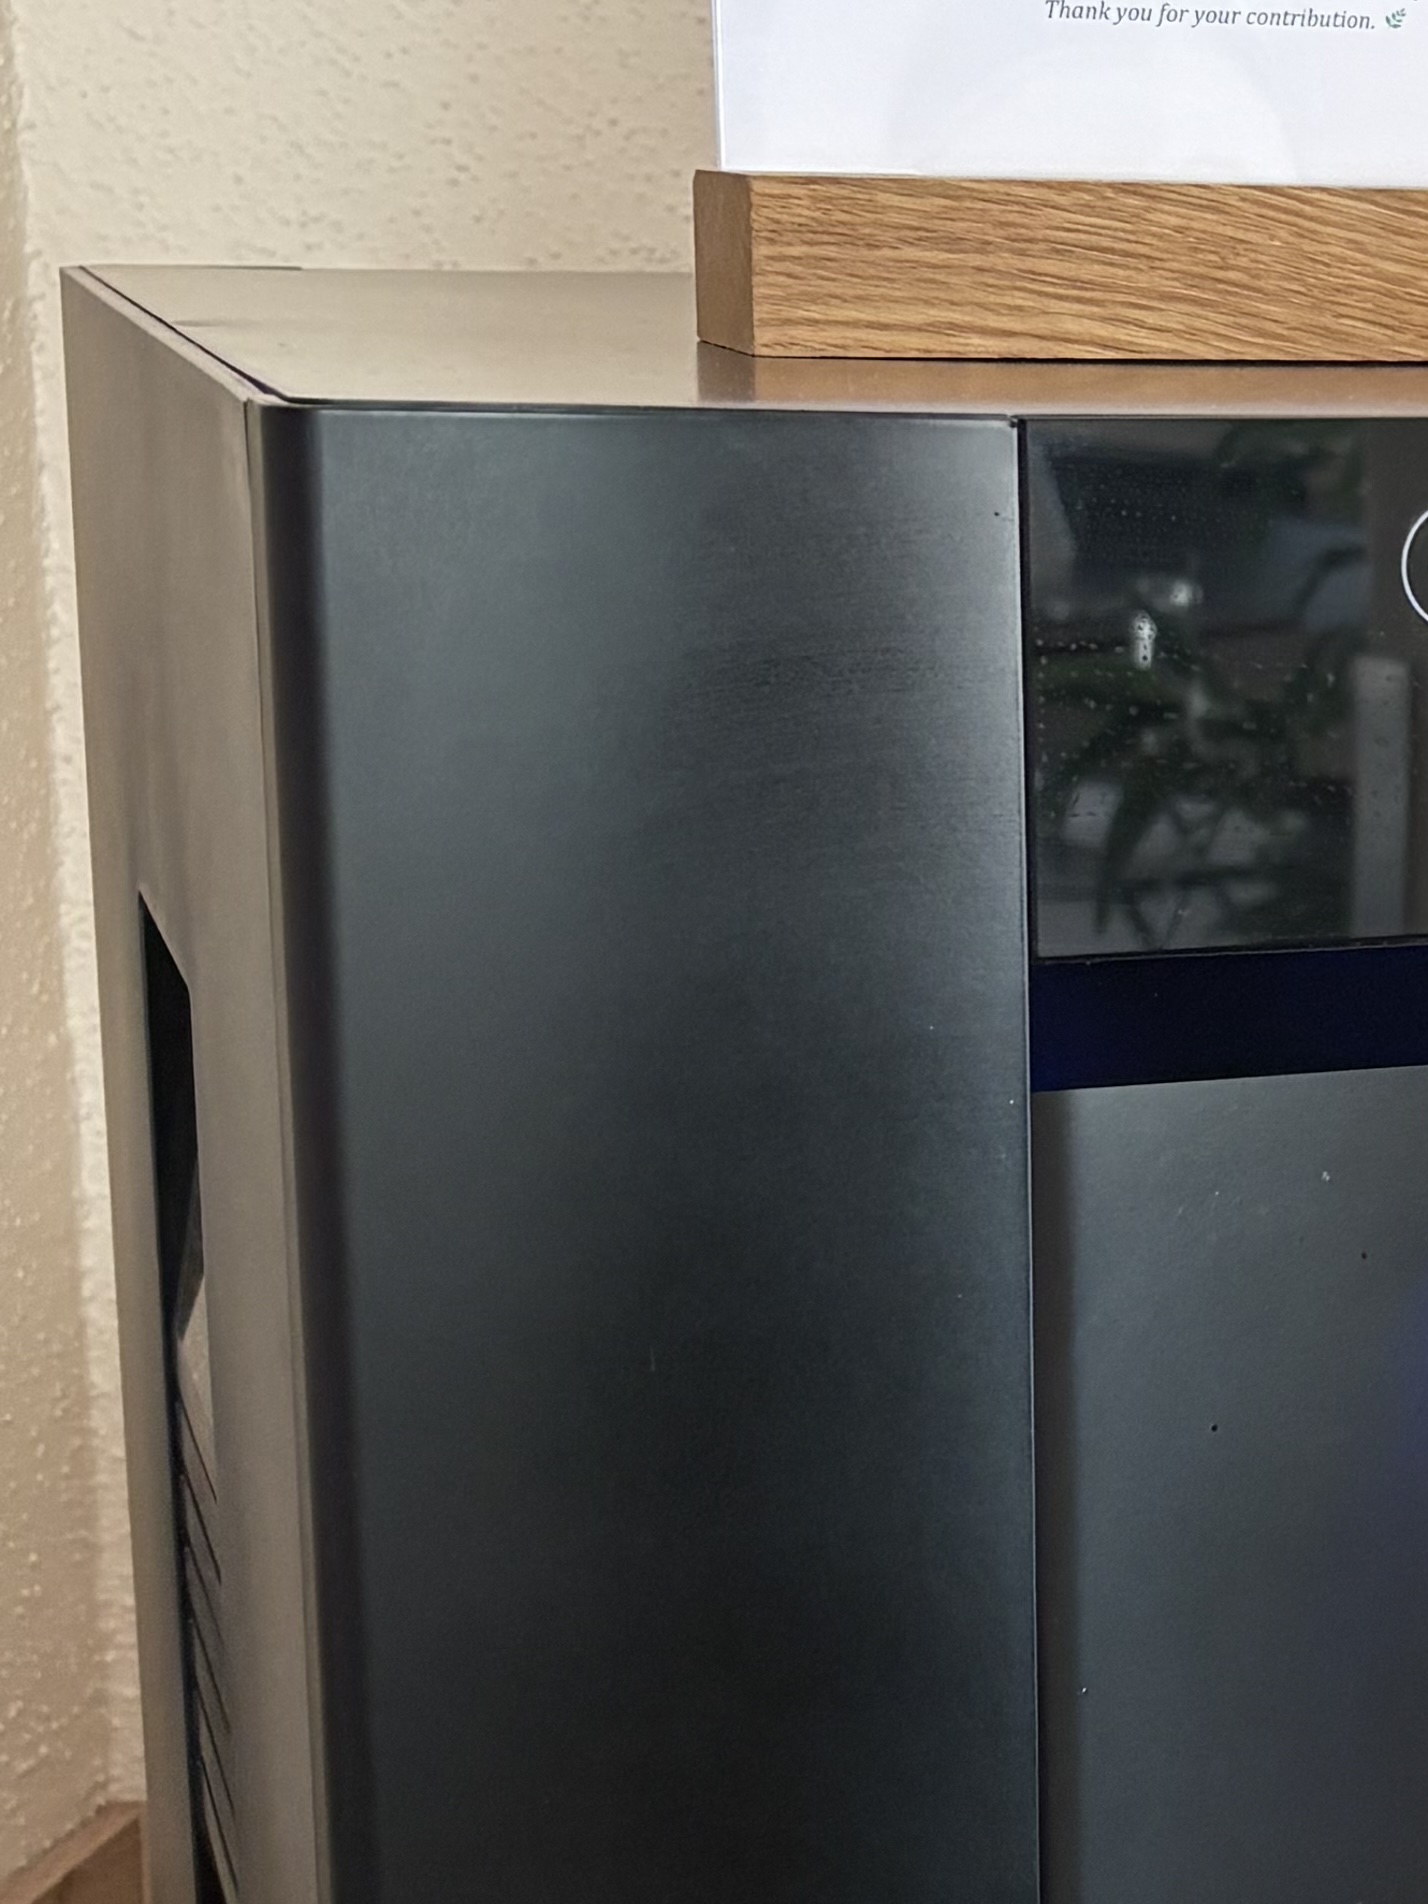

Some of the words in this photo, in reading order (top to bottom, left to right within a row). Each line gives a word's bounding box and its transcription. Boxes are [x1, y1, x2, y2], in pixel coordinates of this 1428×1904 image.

[1112, 6, 1153, 26] you
[1155, 1, 1190, 28] for
[1190, 9, 1242, 29] your
[1245, 7, 1376, 30] contribution.
